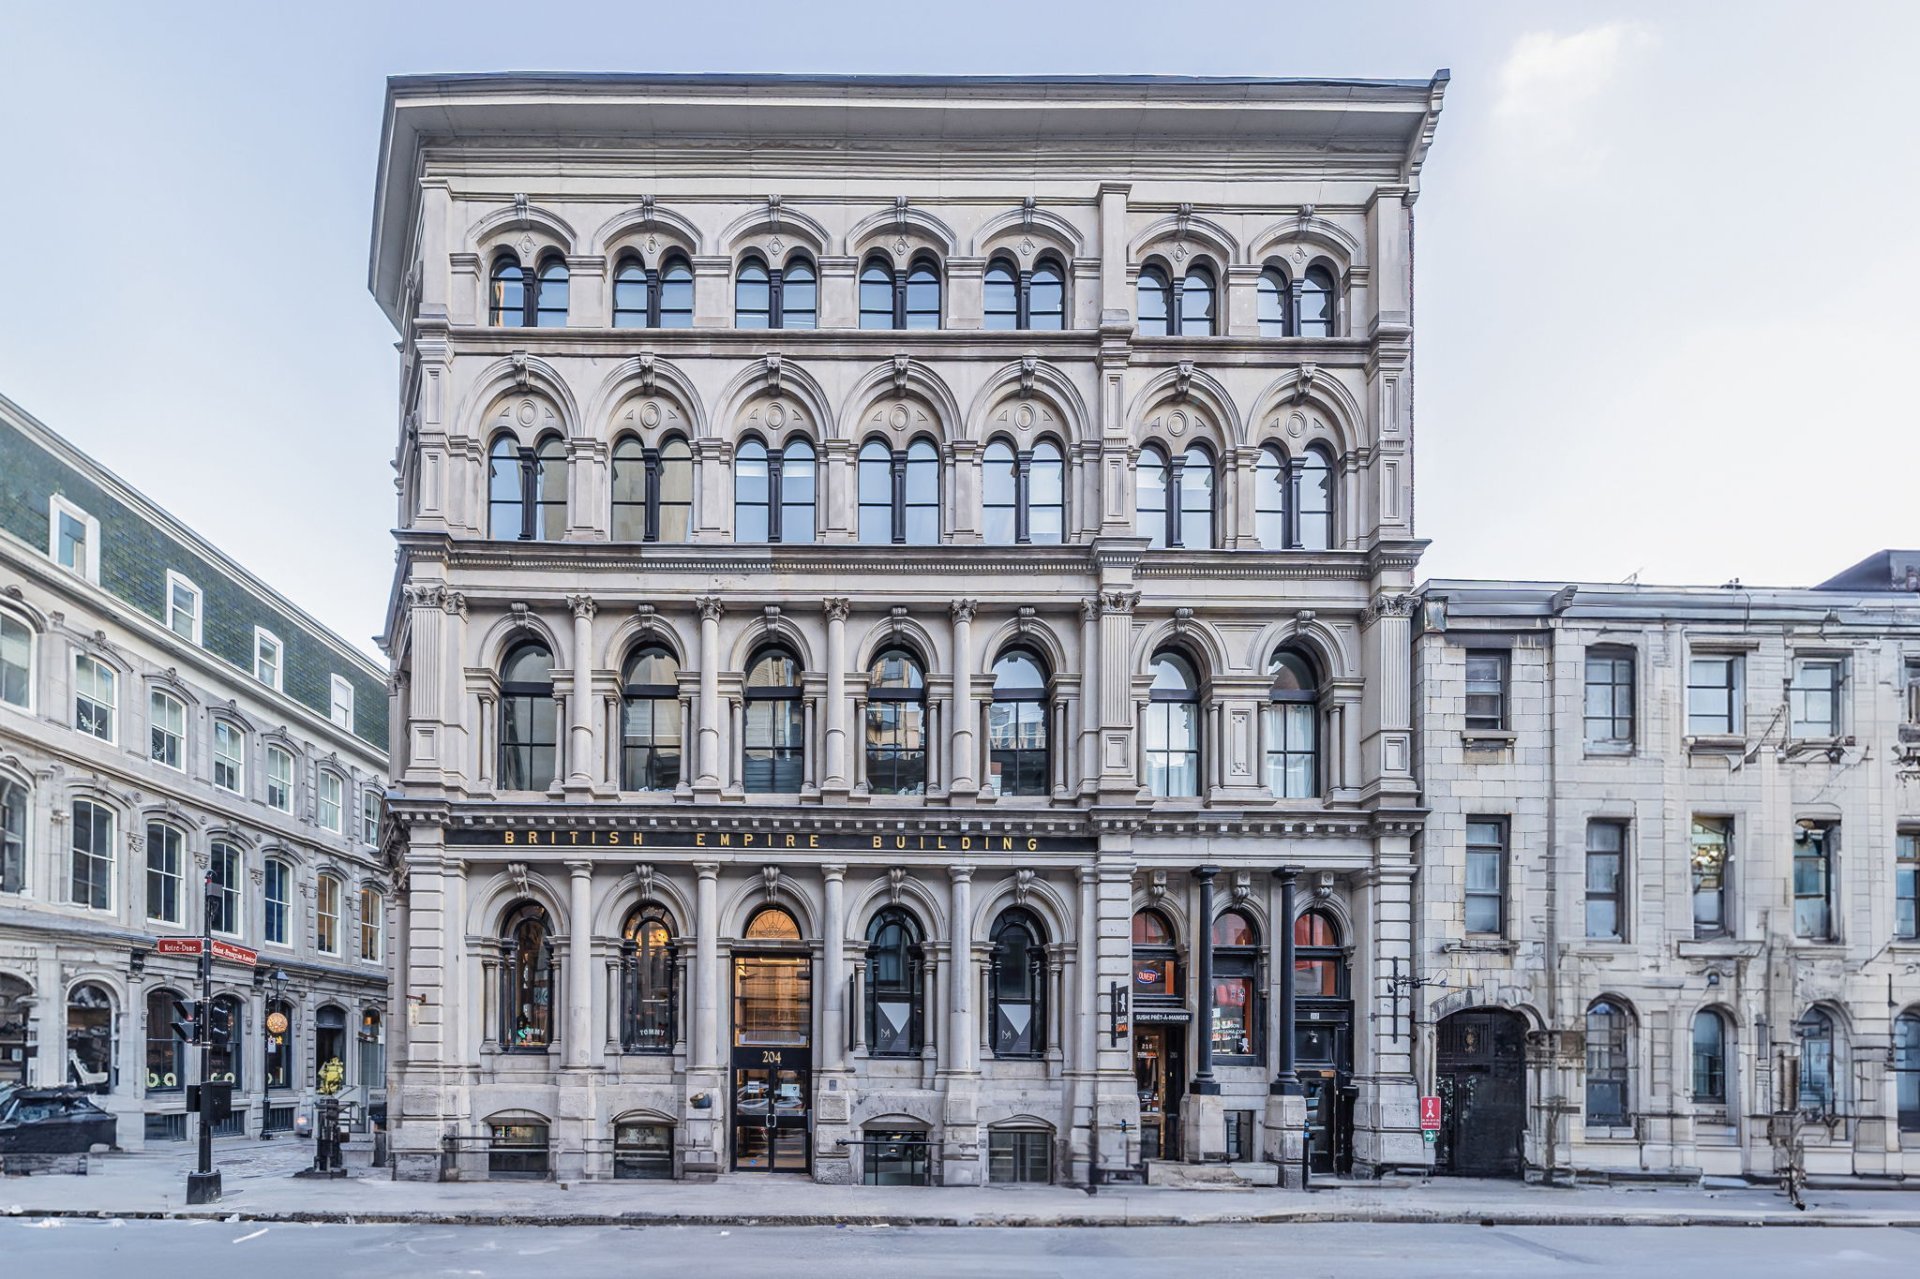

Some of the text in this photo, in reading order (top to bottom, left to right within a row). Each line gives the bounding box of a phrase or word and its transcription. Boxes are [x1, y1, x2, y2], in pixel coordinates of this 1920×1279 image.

[504, 831, 1037, 850] BRITISH EMPIRE BUILDING
[639, 1028, 665, 1036] TOMMY
[762, 1050, 782, 1063] 204
